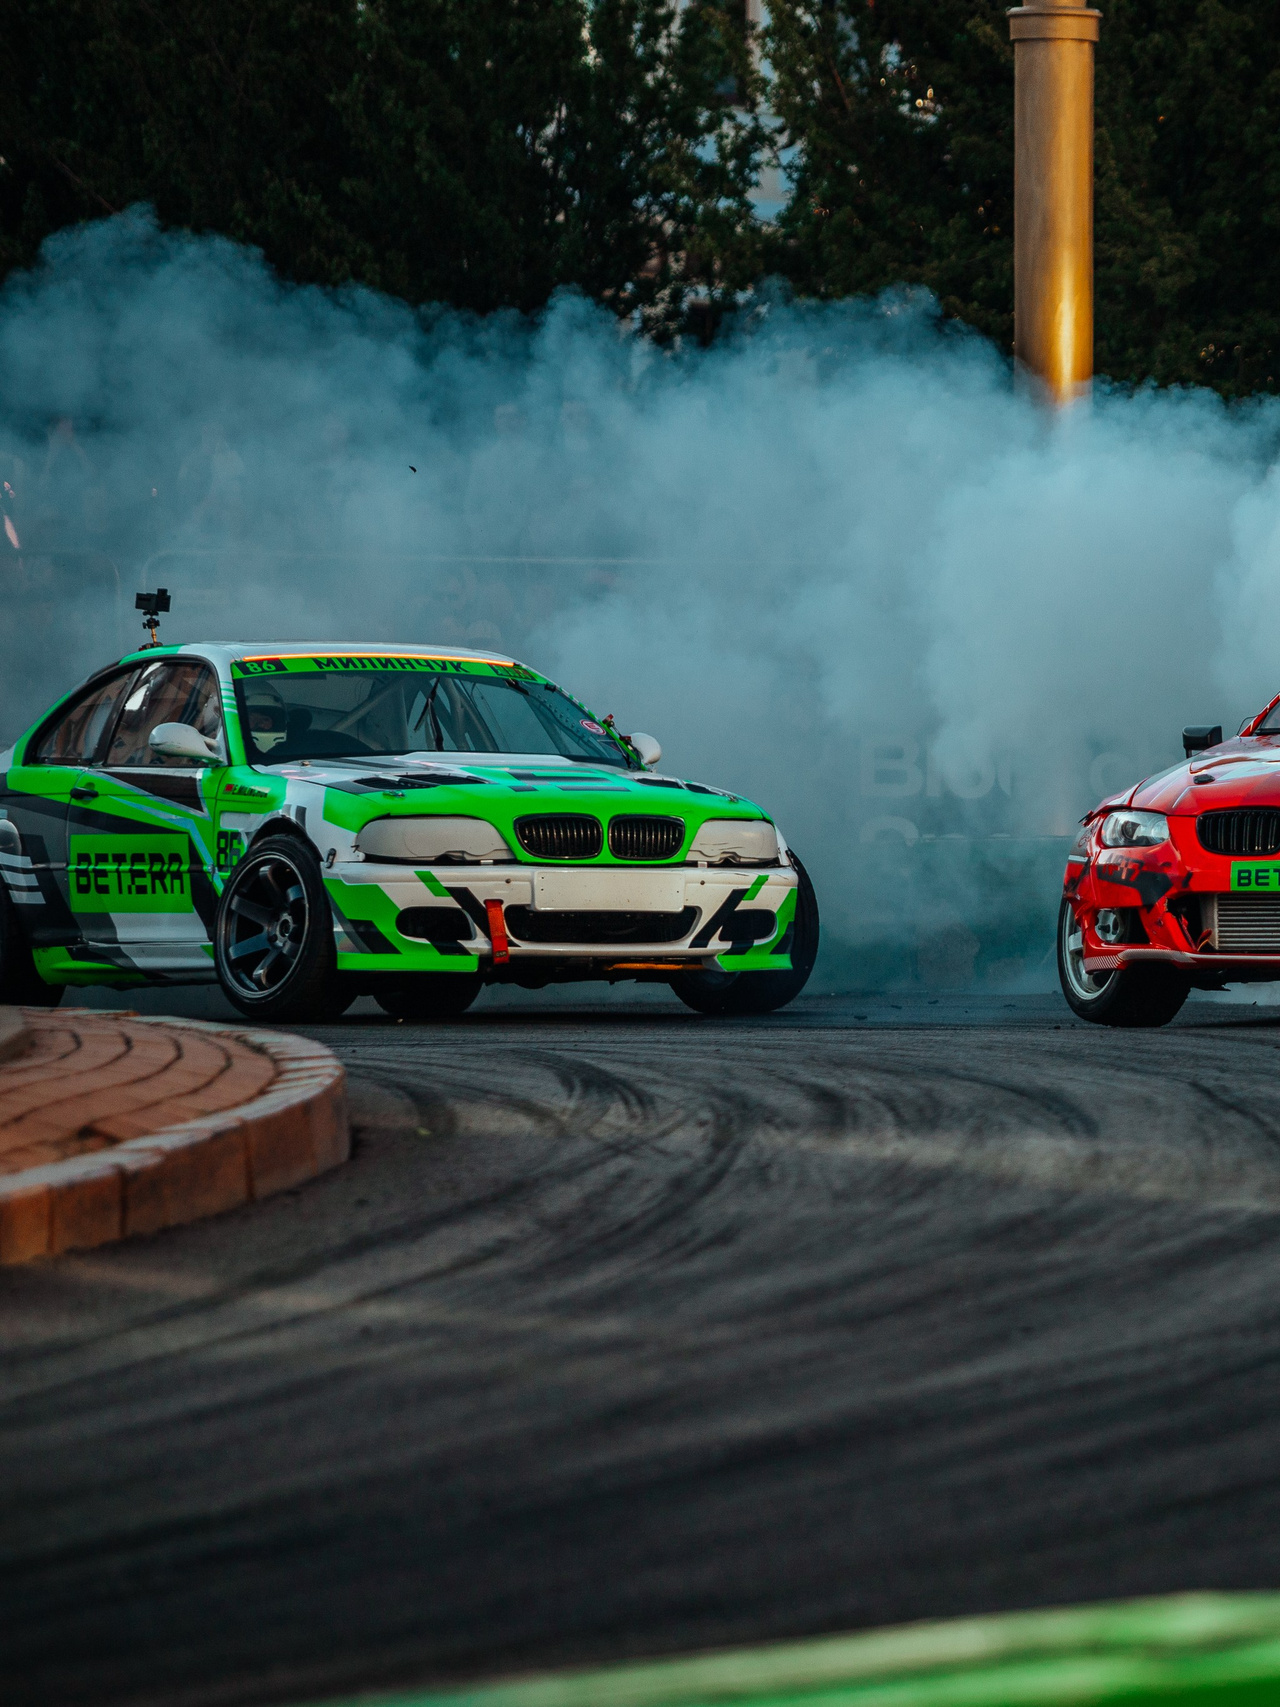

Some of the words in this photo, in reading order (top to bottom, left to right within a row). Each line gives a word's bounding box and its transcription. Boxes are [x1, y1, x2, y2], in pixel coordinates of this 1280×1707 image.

[245, 660, 277, 673] 86
[311, 657, 471, 673] МИЛИНЧУК
[216, 830, 242, 873] 86
